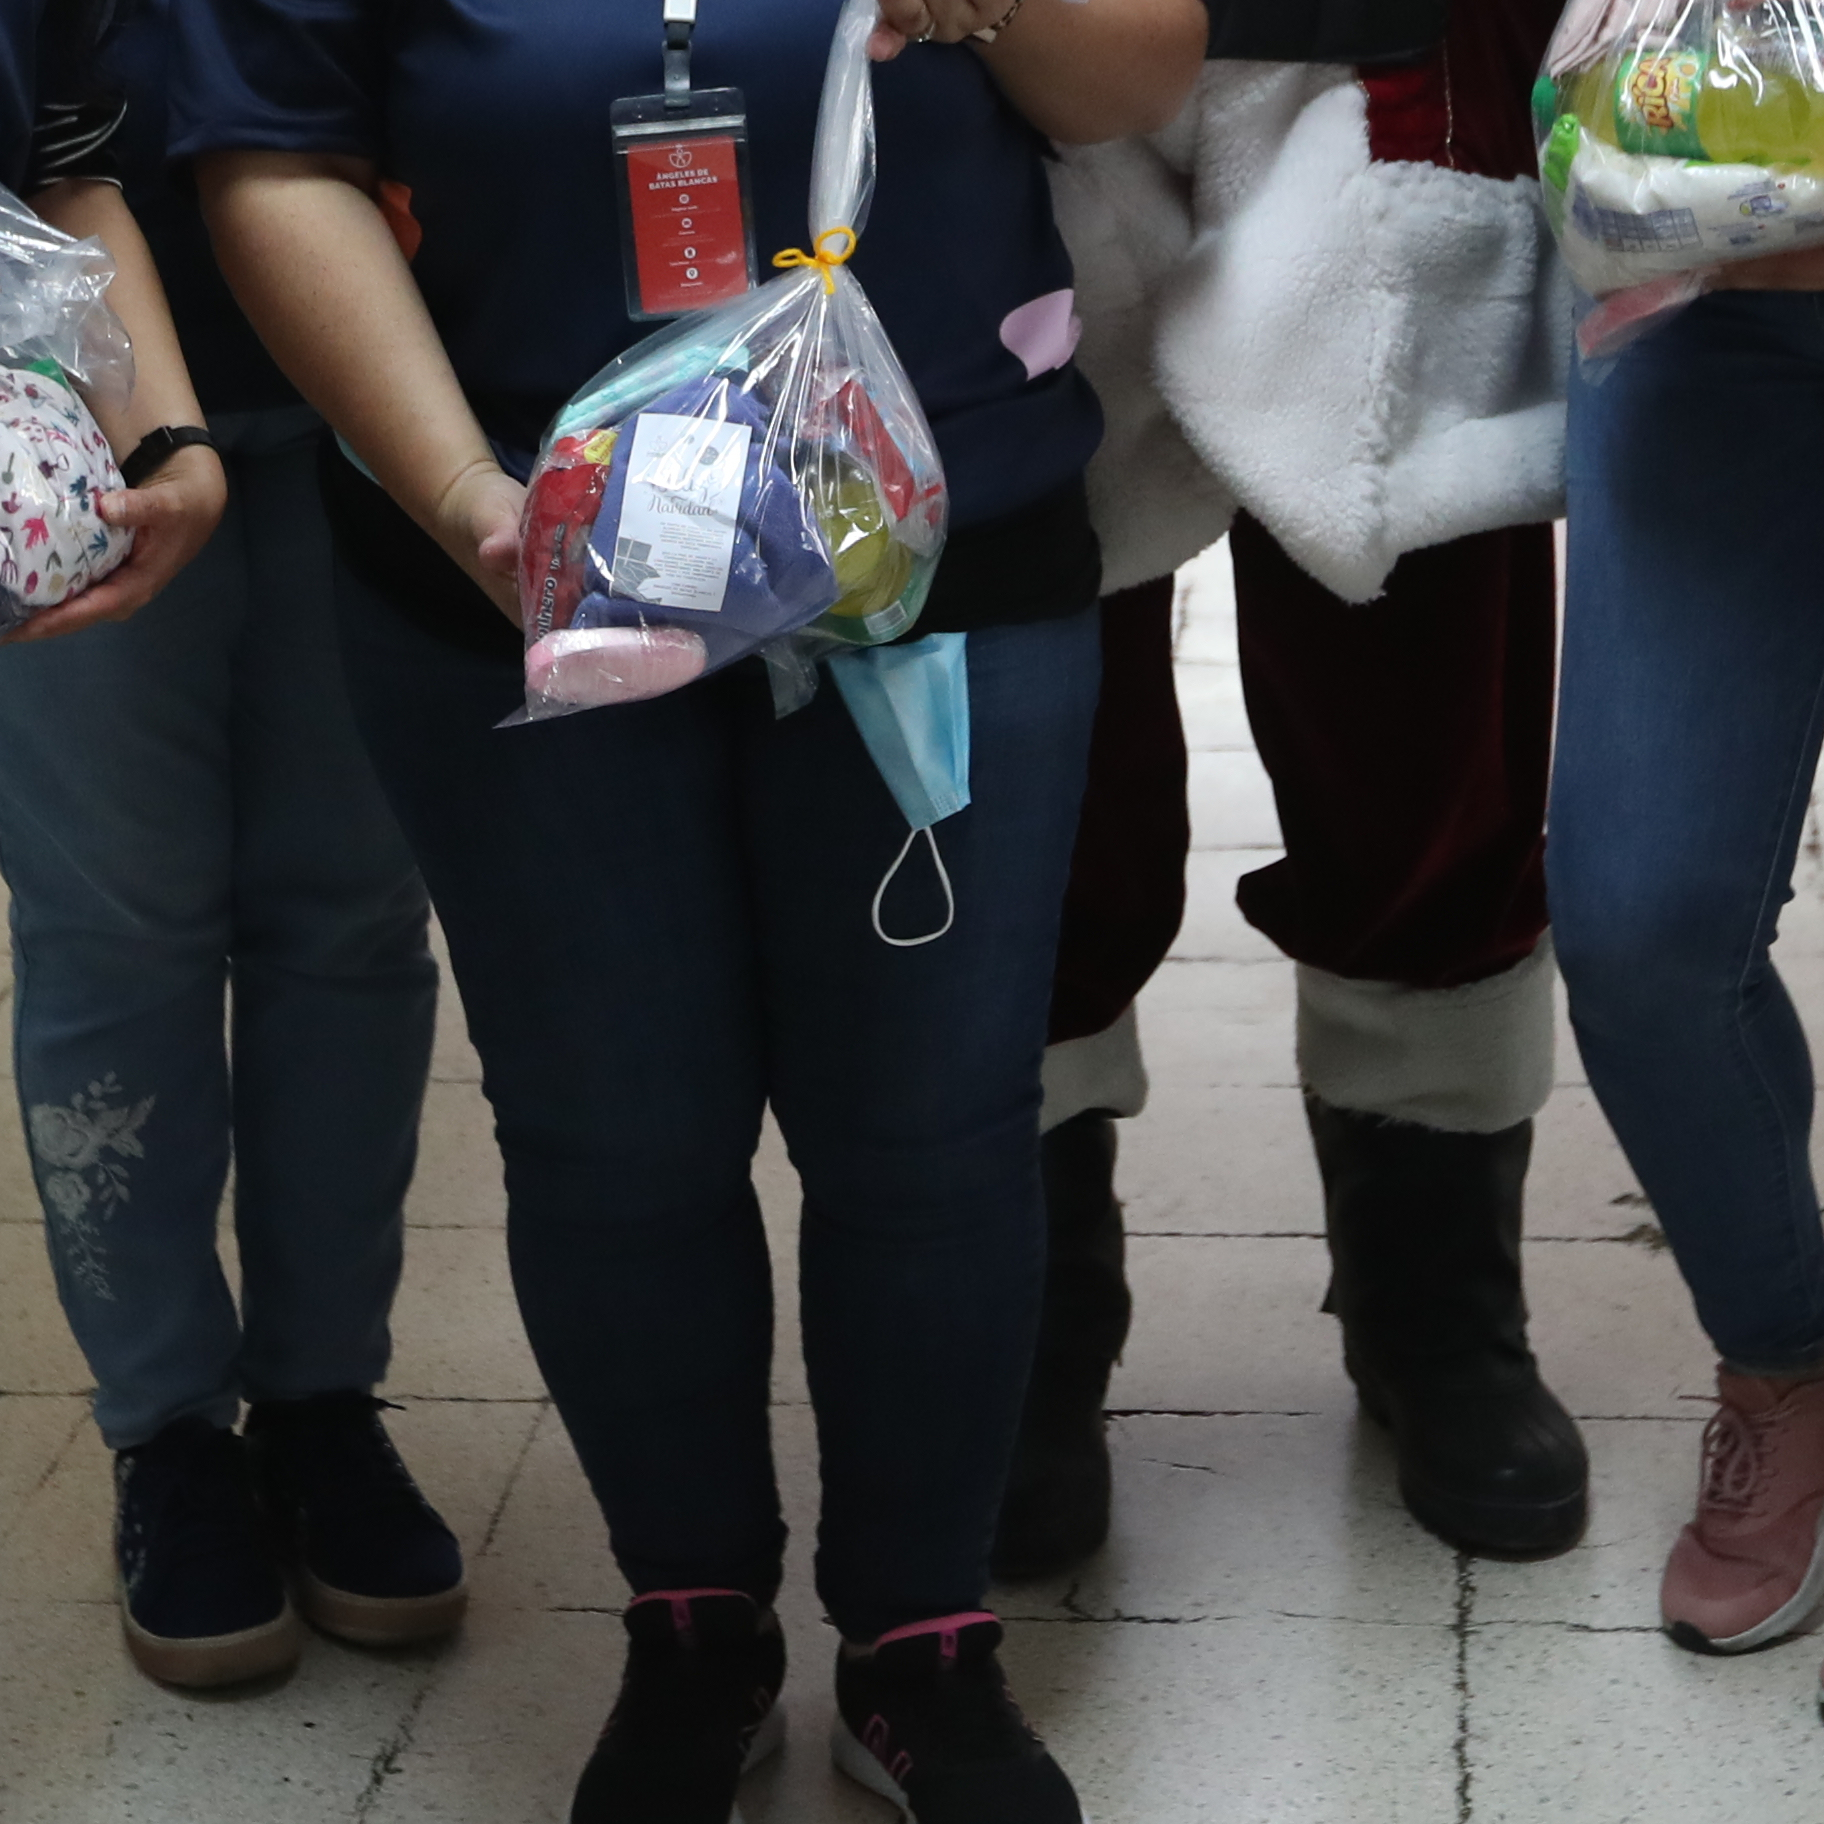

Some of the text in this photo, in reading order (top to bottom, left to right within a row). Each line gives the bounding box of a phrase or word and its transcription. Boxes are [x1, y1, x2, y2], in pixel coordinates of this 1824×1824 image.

[648, 176, 718, 190] BATAS BLANCAS
[536, 576, 558, 643] olinero
